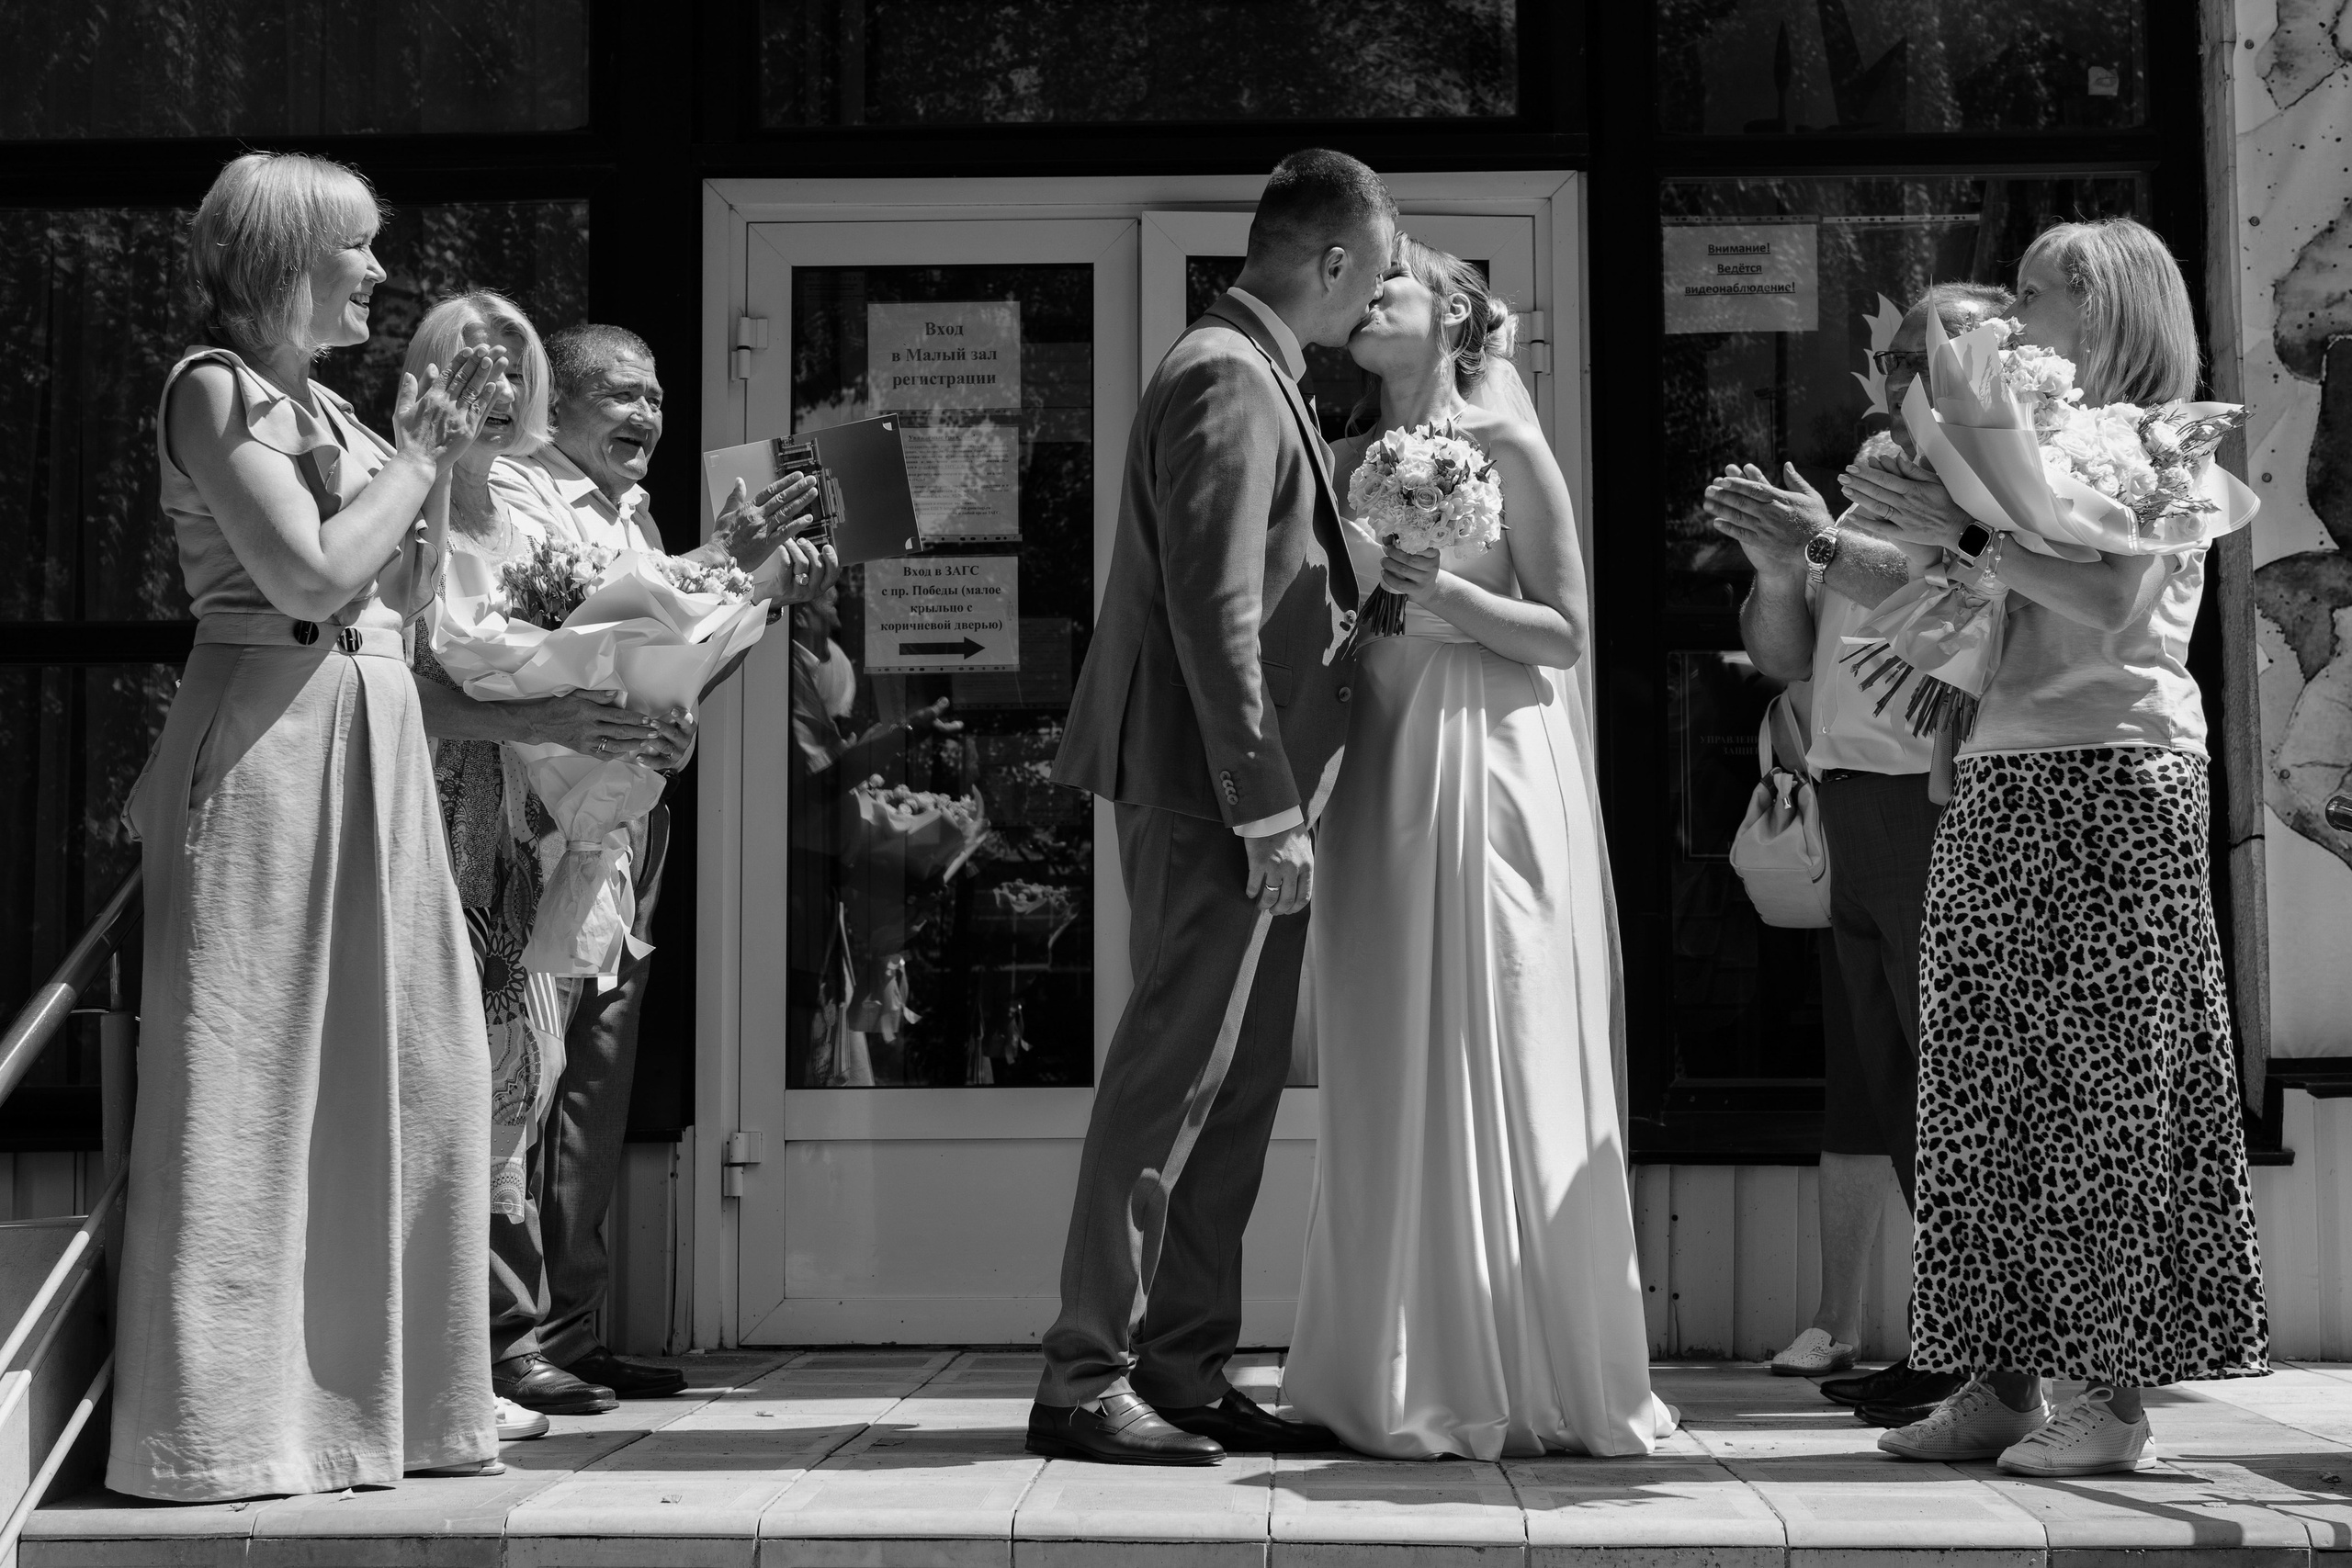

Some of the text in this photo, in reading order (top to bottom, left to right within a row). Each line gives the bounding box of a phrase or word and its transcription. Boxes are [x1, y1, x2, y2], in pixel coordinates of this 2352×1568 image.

[1707, 243, 1770, 255] Внимание!
[1717, 263, 1762, 275] Ведётся
[1685, 282, 1796, 296] видеонаблюдение!
[924, 321, 965, 336] Вход
[891, 347, 998, 362] в Малый зал
[892, 373, 997, 389] регистрации
[902, 565, 979, 578] Вход в ЗАГС
[891, 588, 909, 599] пр.
[912, 586, 958, 597] Победы
[961, 585, 1001, 598] (малое
[910, 604, 973, 615] крыльцо с
[880, 620, 1003, 634] коричневой дверью)
